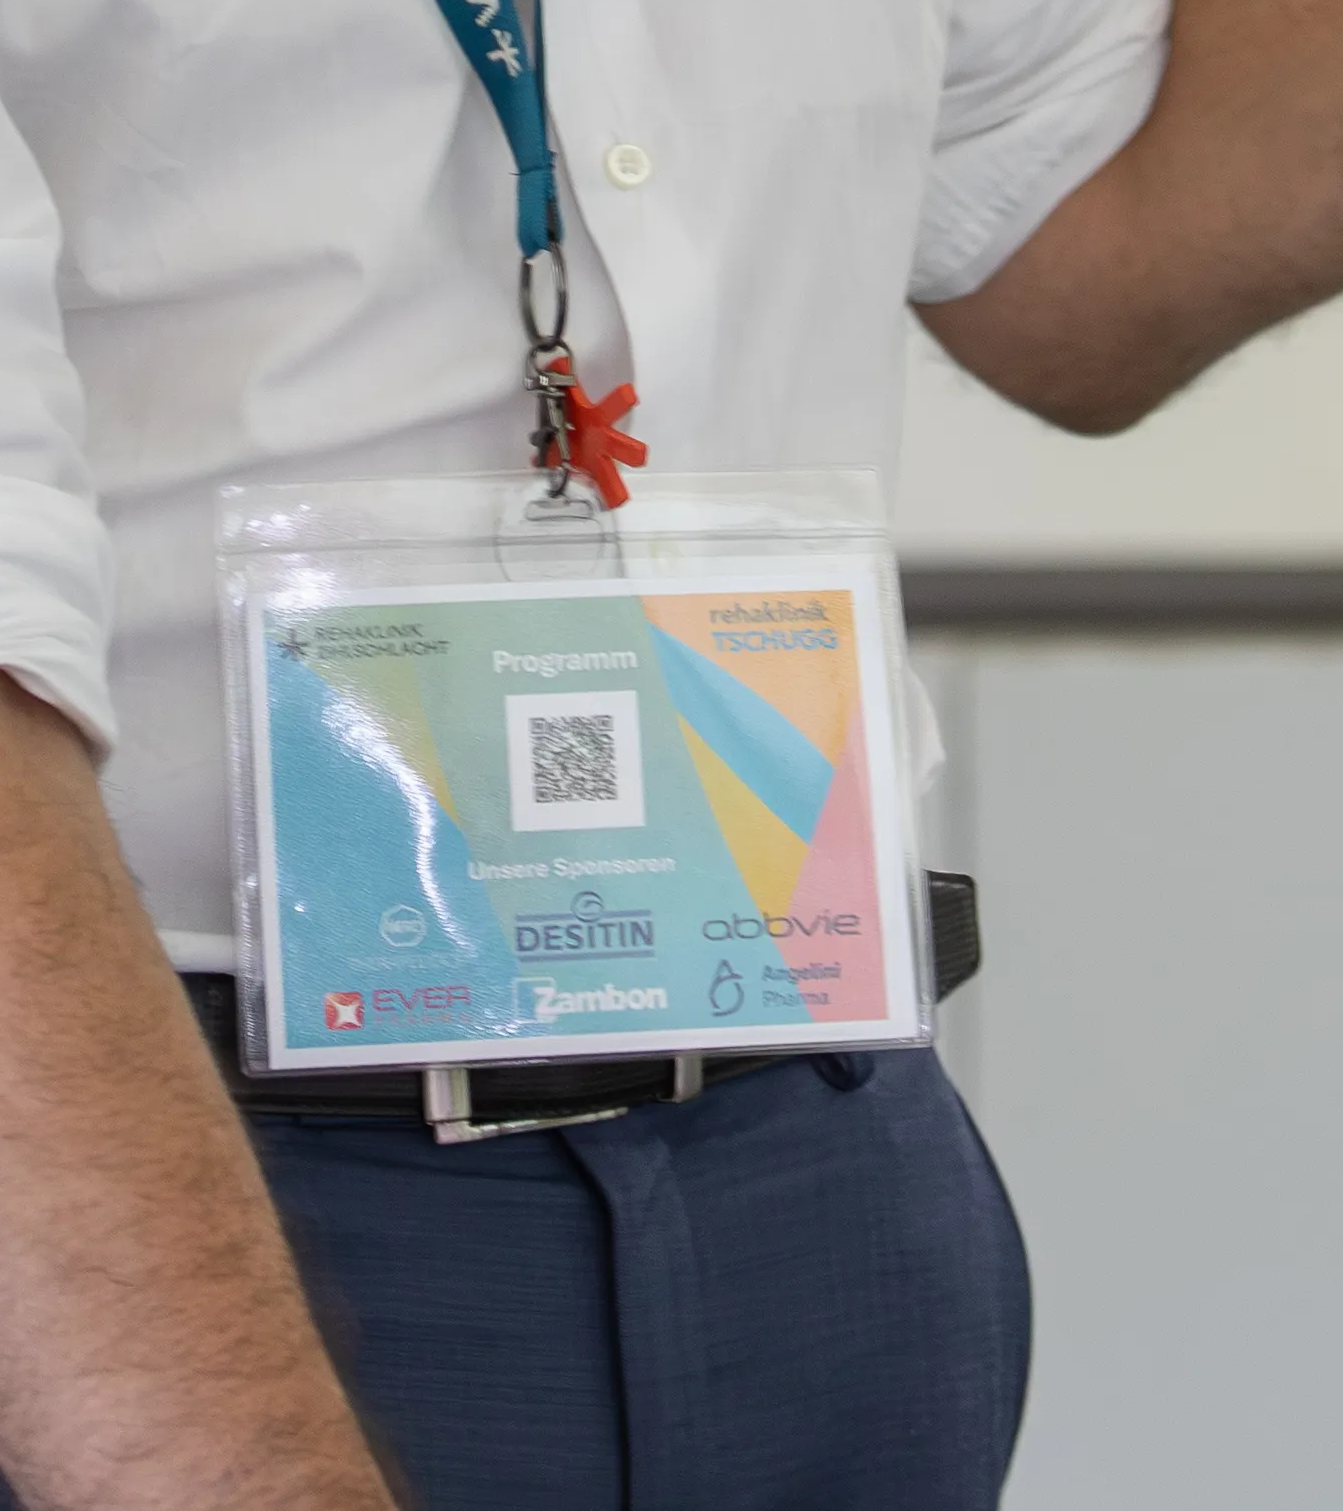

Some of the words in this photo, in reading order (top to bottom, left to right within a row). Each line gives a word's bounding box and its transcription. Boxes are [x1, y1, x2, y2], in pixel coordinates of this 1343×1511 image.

[710, 628, 838, 652] TSCHUGG
[492, 650, 638, 678] Programm
[468, 859, 549, 880] Unsere
[553, 857, 676, 879] Sponsoren
[515, 921, 654, 952] DESITIN
[702, 909, 862, 941] abbvie
[372, 984, 471, 1012] EVER
[533, 983, 668, 1016] Zambon
